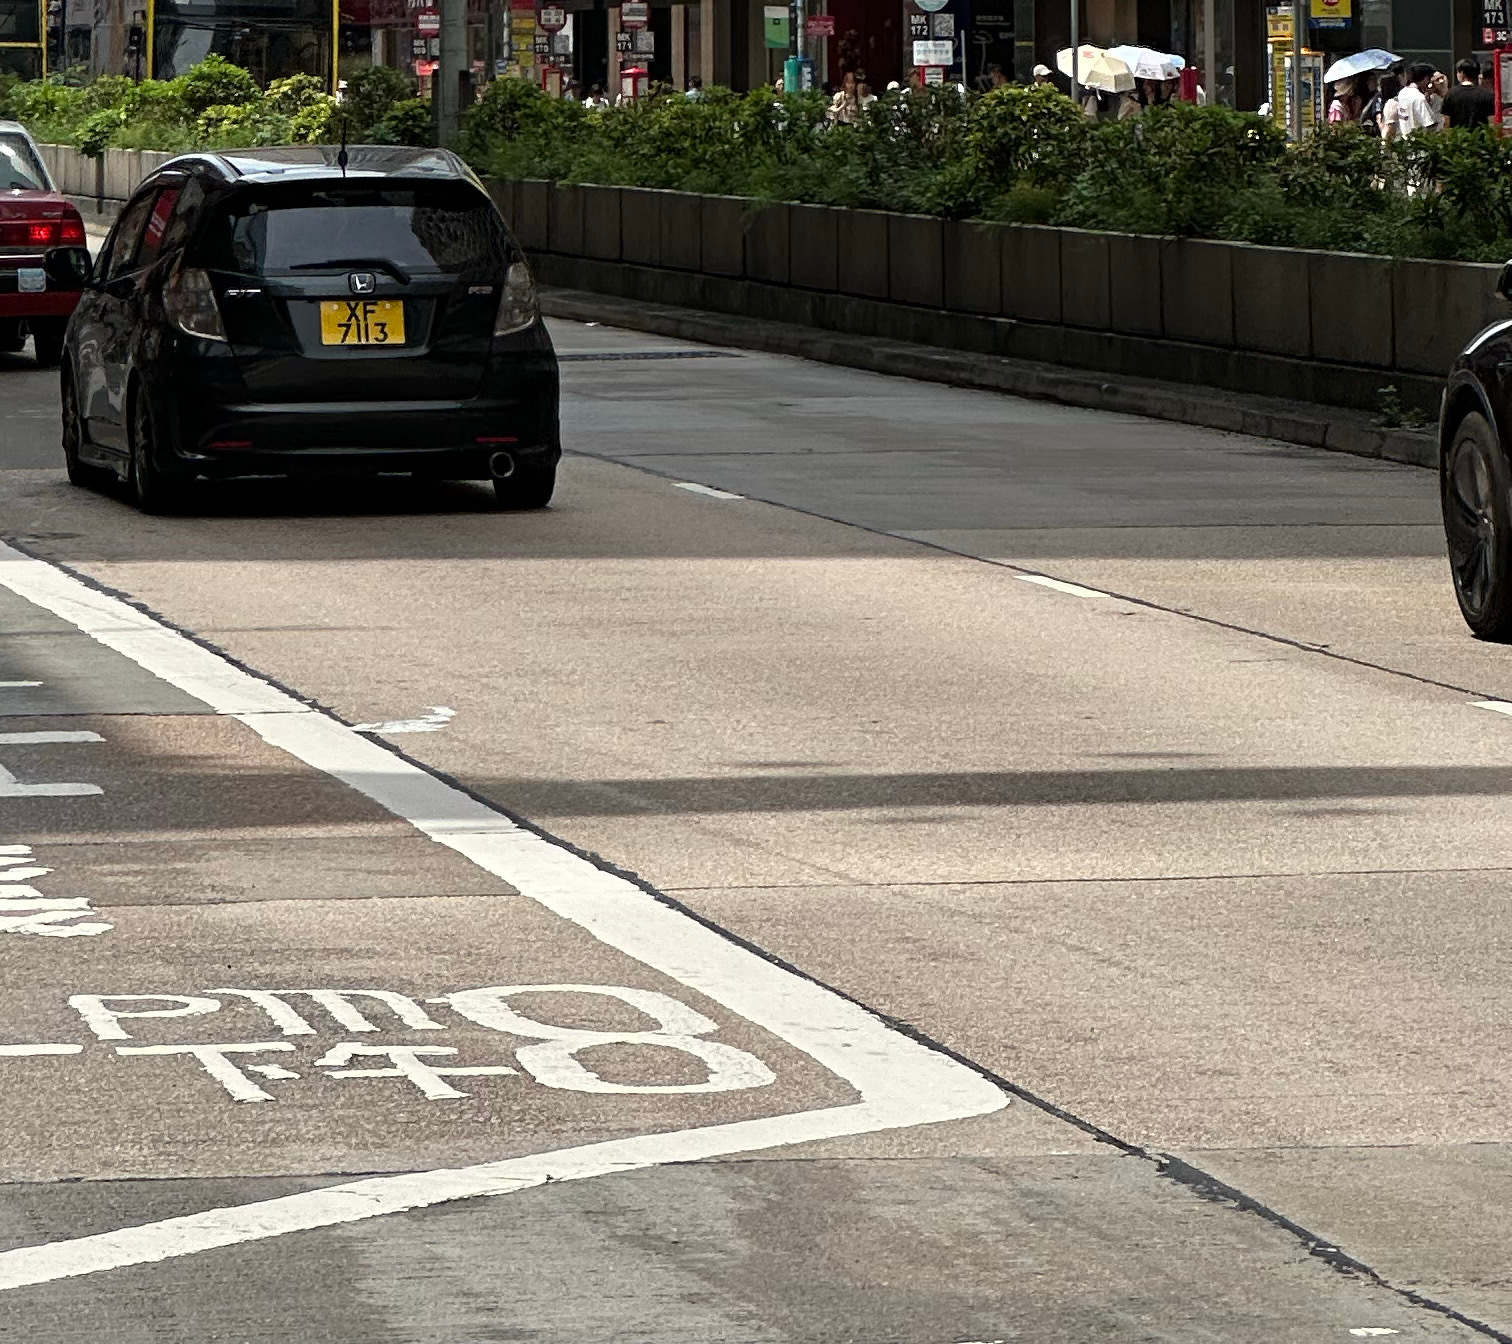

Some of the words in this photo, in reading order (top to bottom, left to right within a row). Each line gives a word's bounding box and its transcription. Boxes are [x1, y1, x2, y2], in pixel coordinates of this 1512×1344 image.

[345, 301, 379, 322] XF
[337, 323, 389, 344] 7113
[444, 983, 778, 1095] 8
